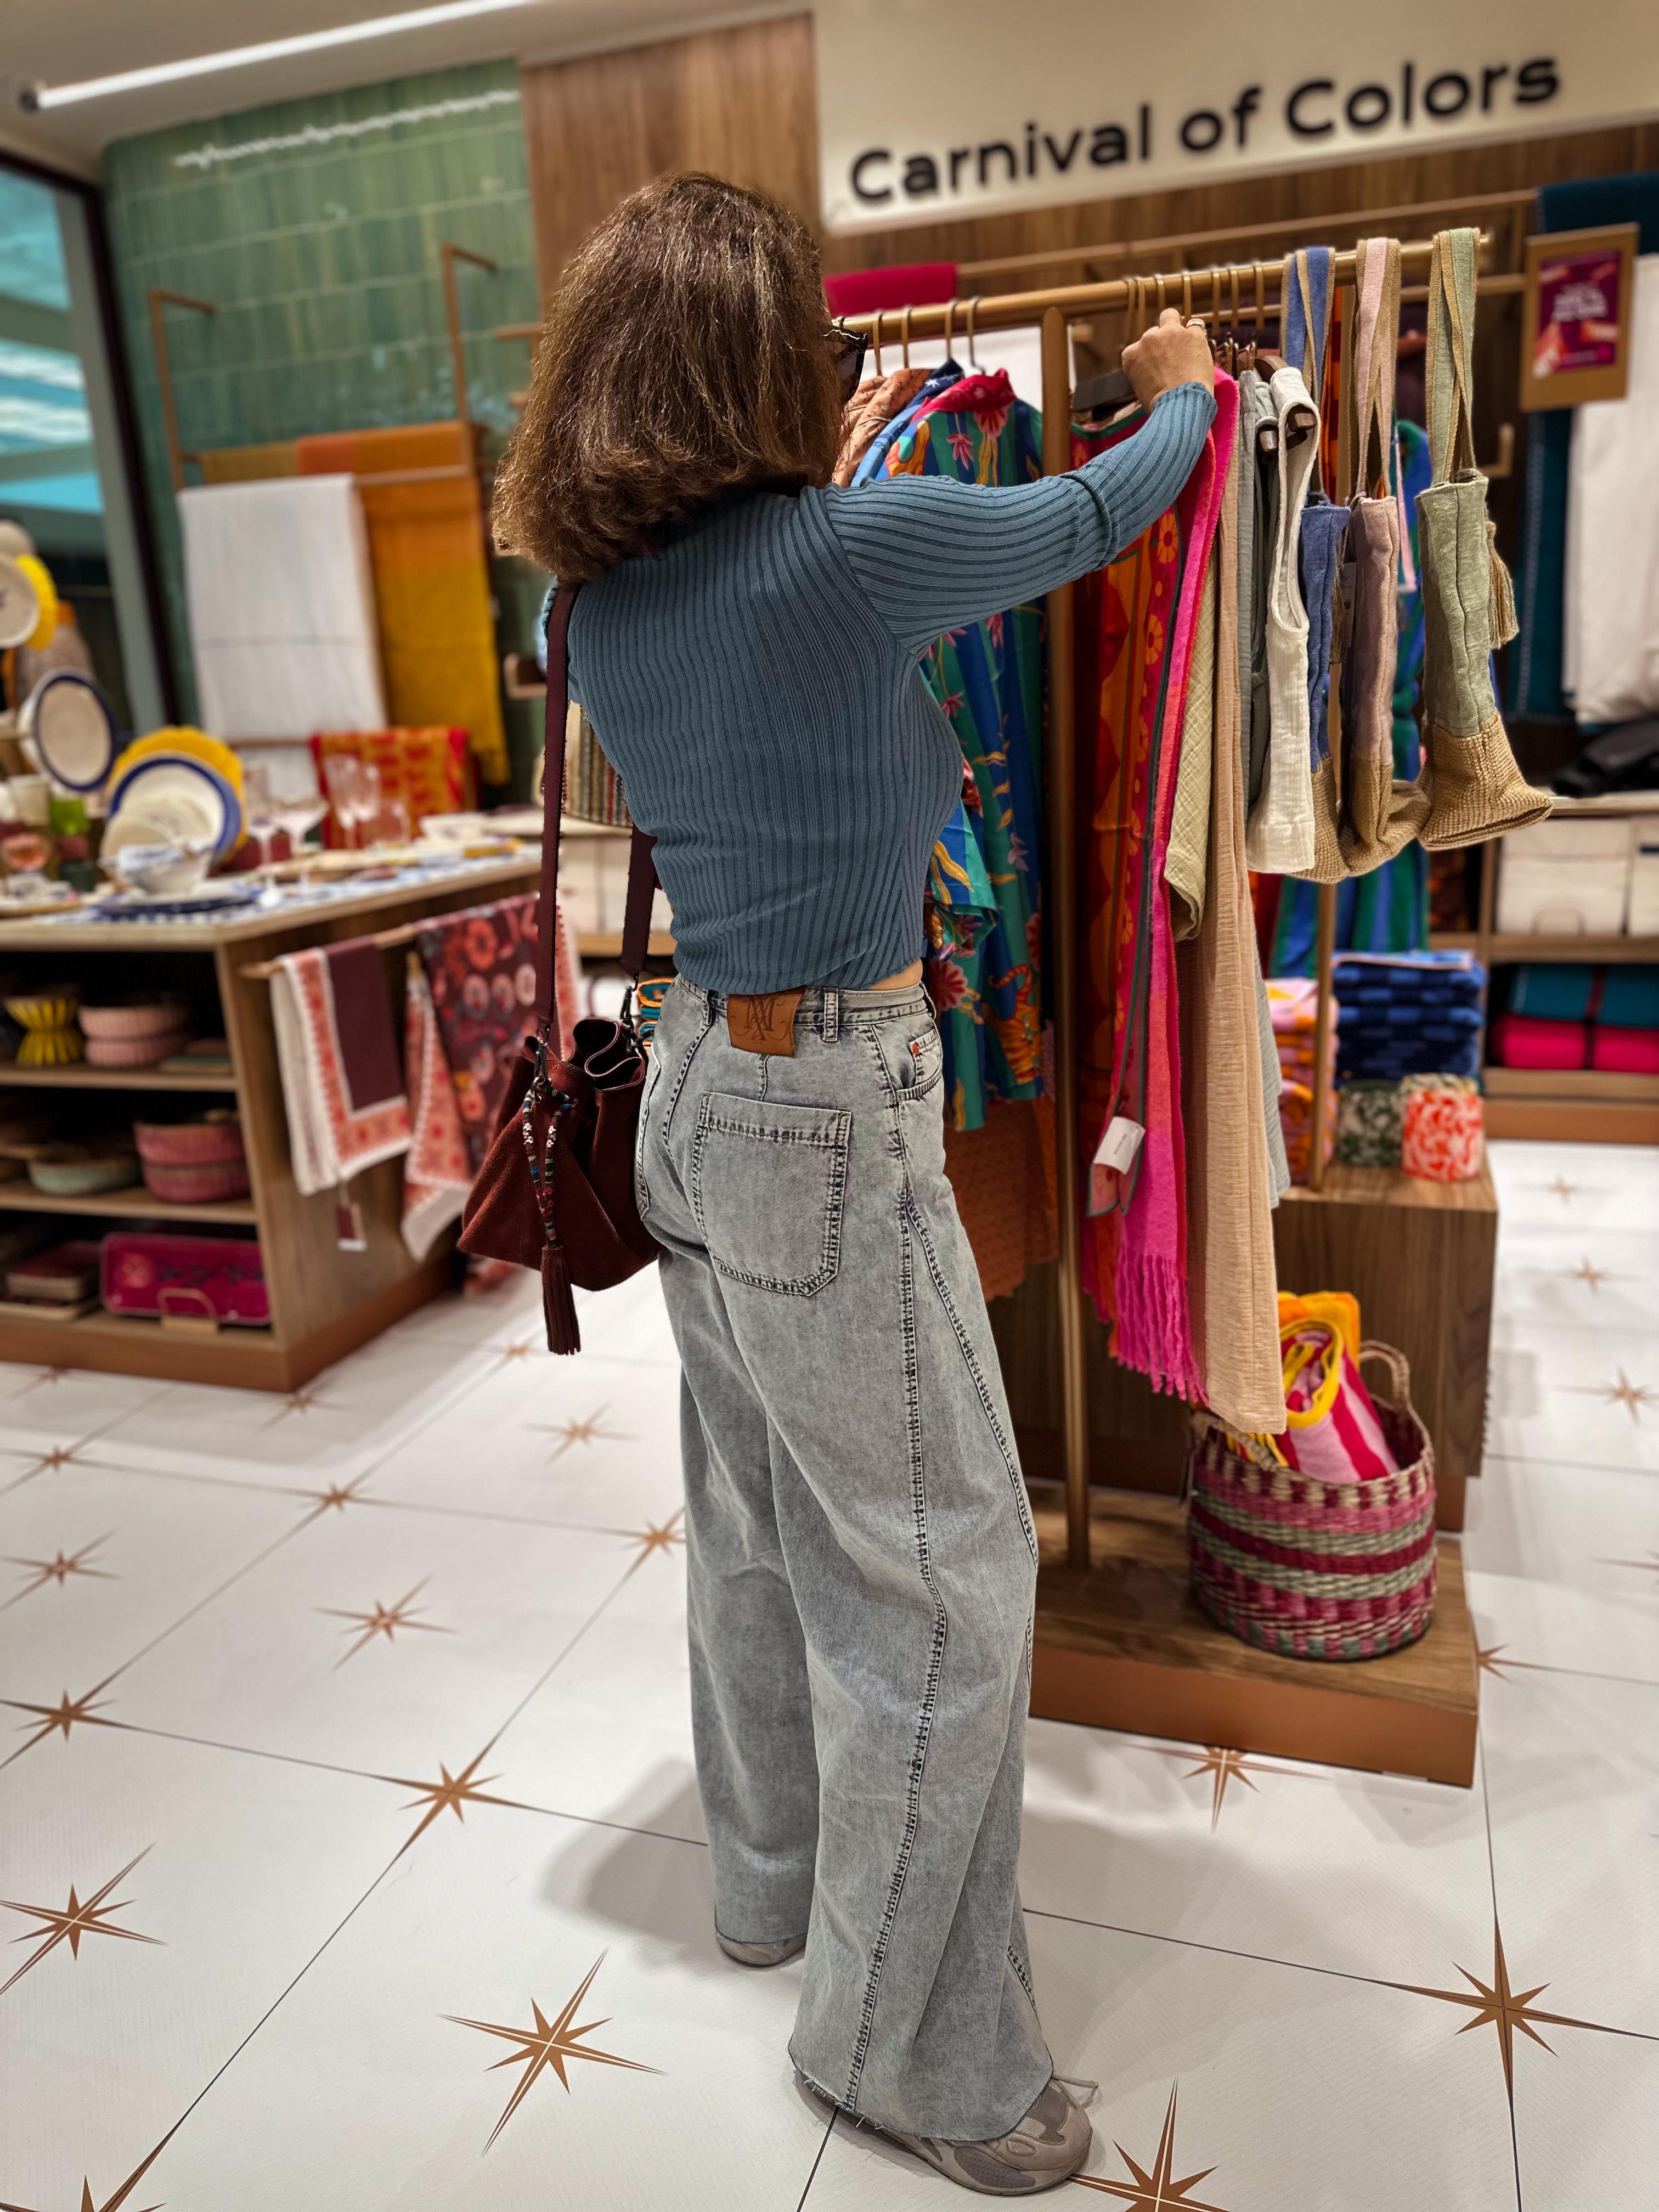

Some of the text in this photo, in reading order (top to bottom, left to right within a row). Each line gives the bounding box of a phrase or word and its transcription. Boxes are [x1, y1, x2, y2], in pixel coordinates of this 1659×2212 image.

[850, 56, 1562, 202] Carnival of Colors
